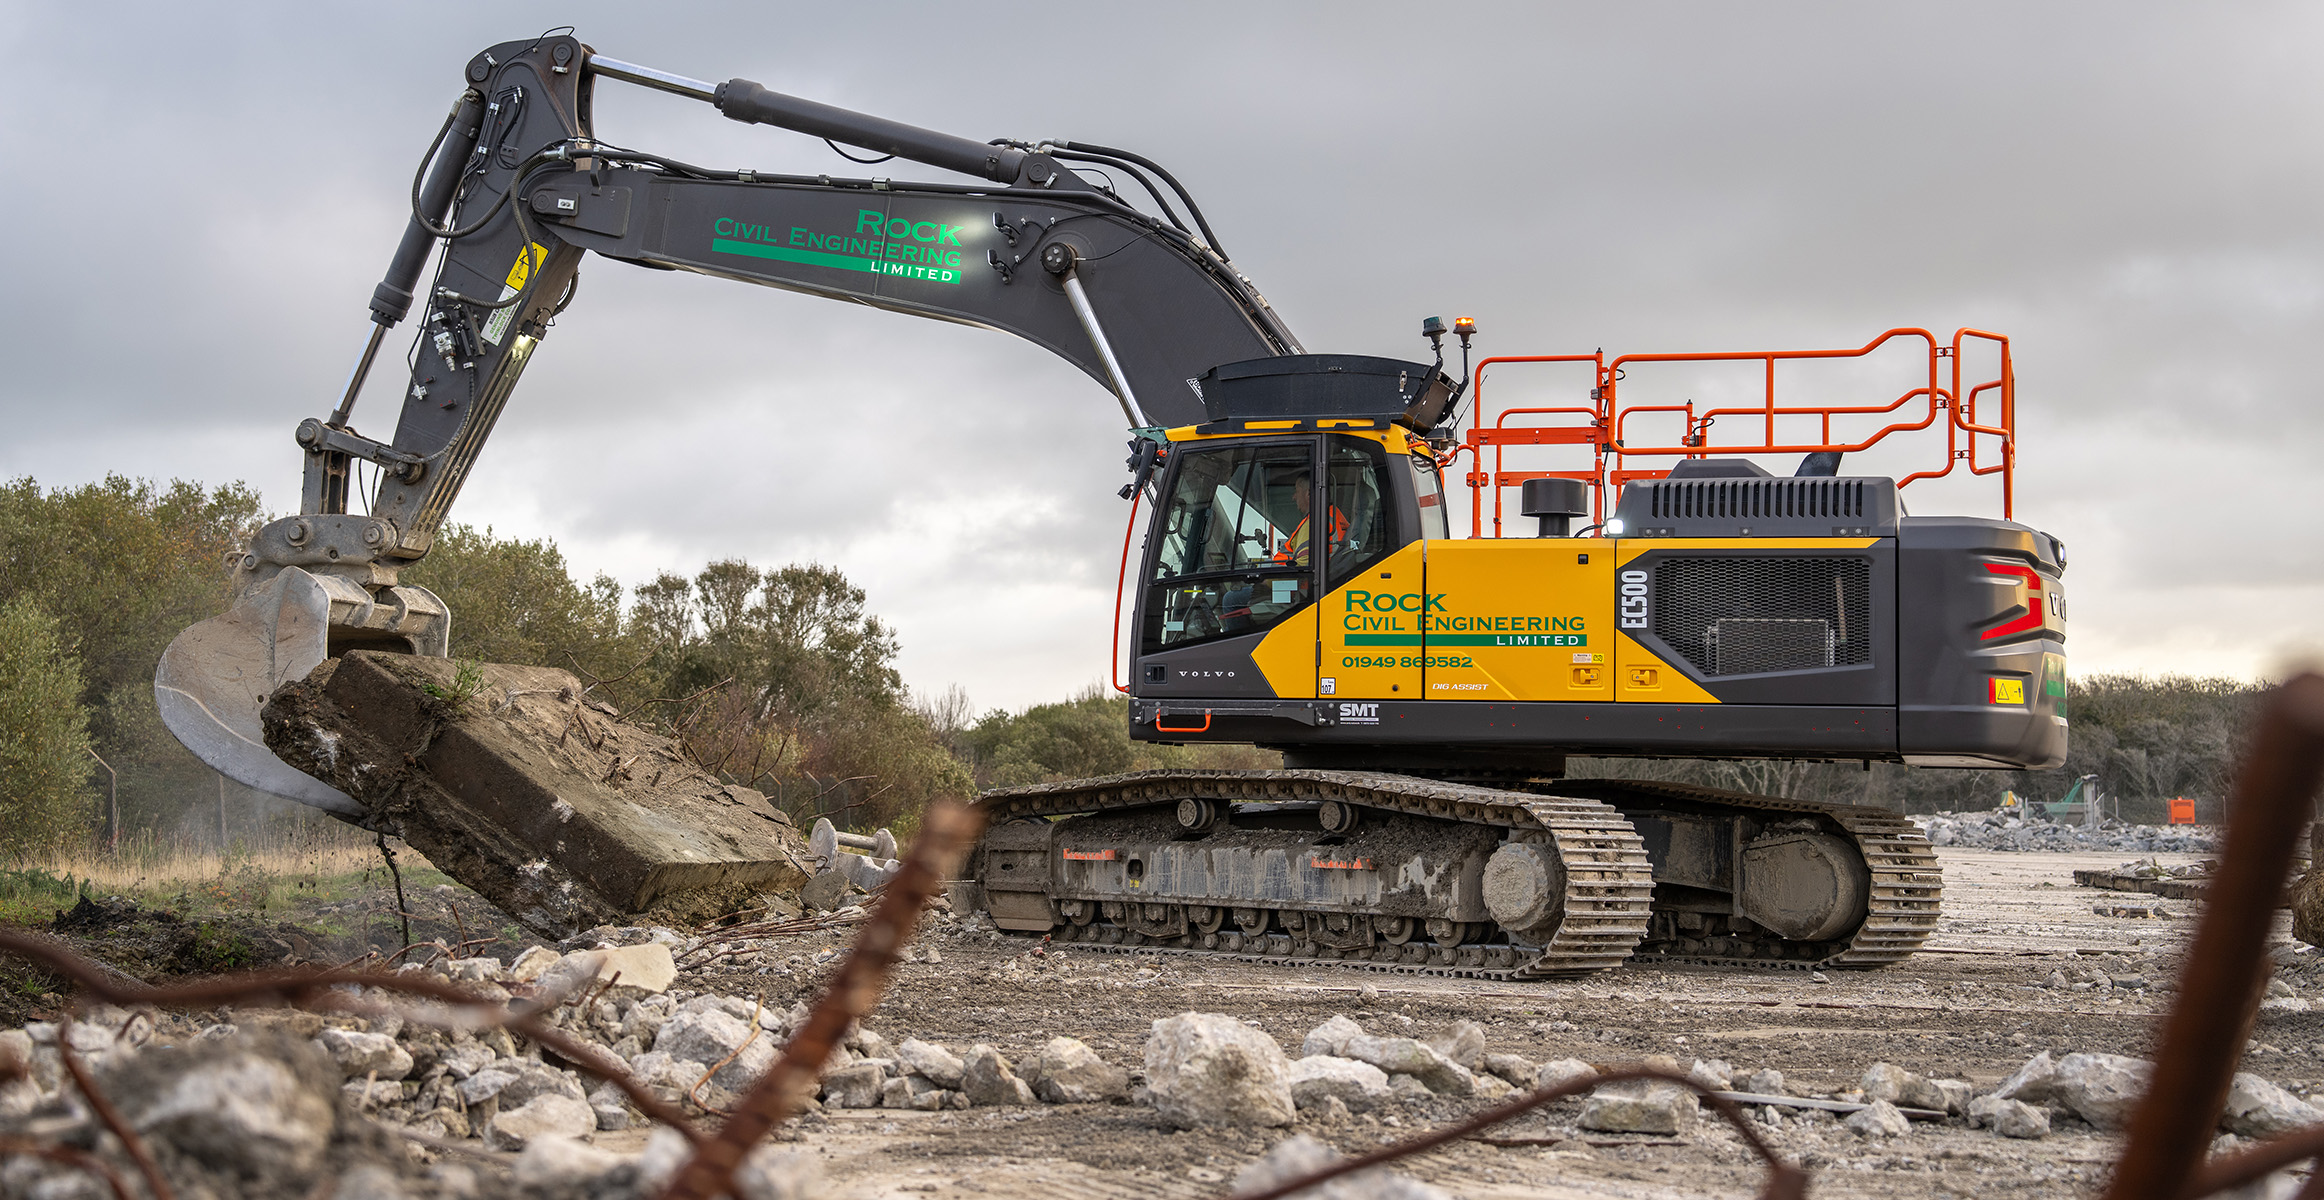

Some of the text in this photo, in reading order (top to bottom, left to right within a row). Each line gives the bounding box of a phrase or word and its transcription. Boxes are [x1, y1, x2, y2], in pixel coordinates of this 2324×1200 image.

[871, 261, 953, 282] LIMITED
[1621, 570, 1648, 628] EC500
[1496, 636, 1579, 645] LIMITED
[1342, 656, 1473, 668] 01949 869582
[1321, 685, 1332, 693] 107
[1451, 683, 1489, 691] ASSIST
[1340, 703, 1379, 717] SMT
